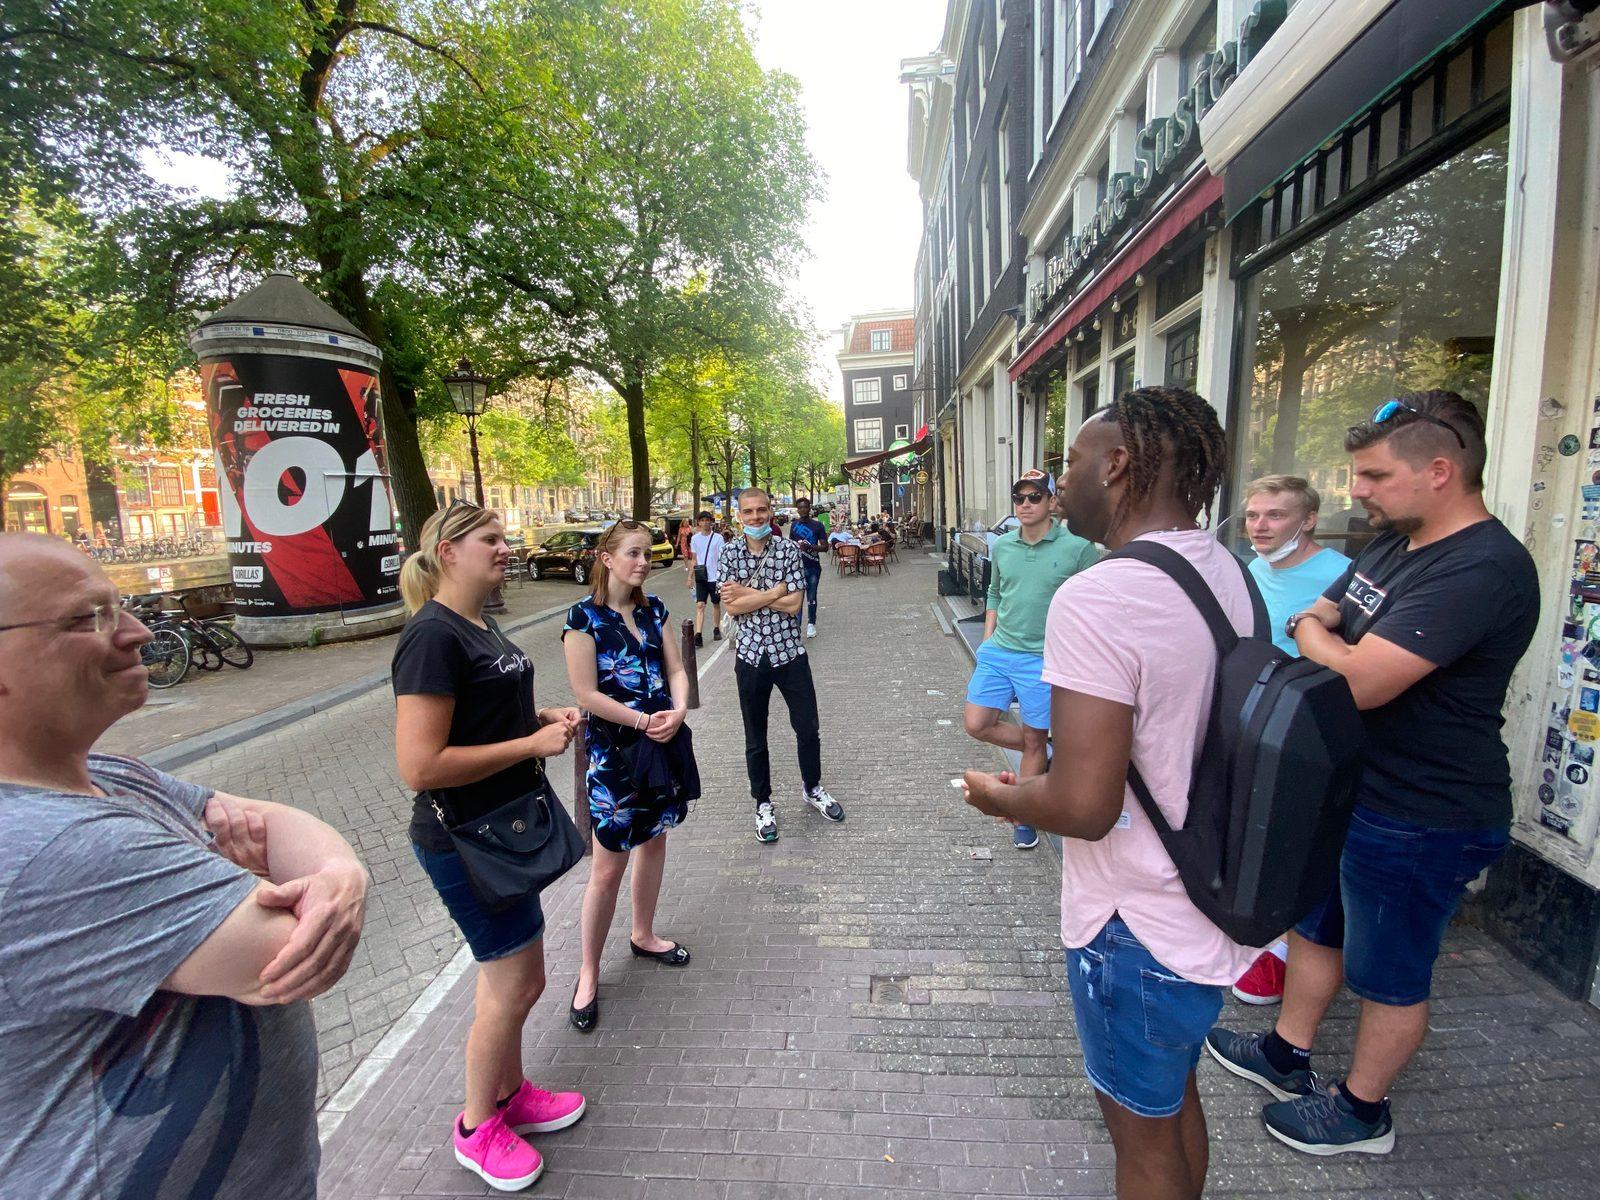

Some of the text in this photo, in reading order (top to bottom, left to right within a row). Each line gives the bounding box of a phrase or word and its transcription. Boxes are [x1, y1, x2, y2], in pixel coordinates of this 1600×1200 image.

[253, 393, 311, 406] FRESH
[237, 407, 333, 420] GROCERIES
[234, 420, 340, 434] DELIVERED IN
[235, 569, 259, 580] GORILLAS
